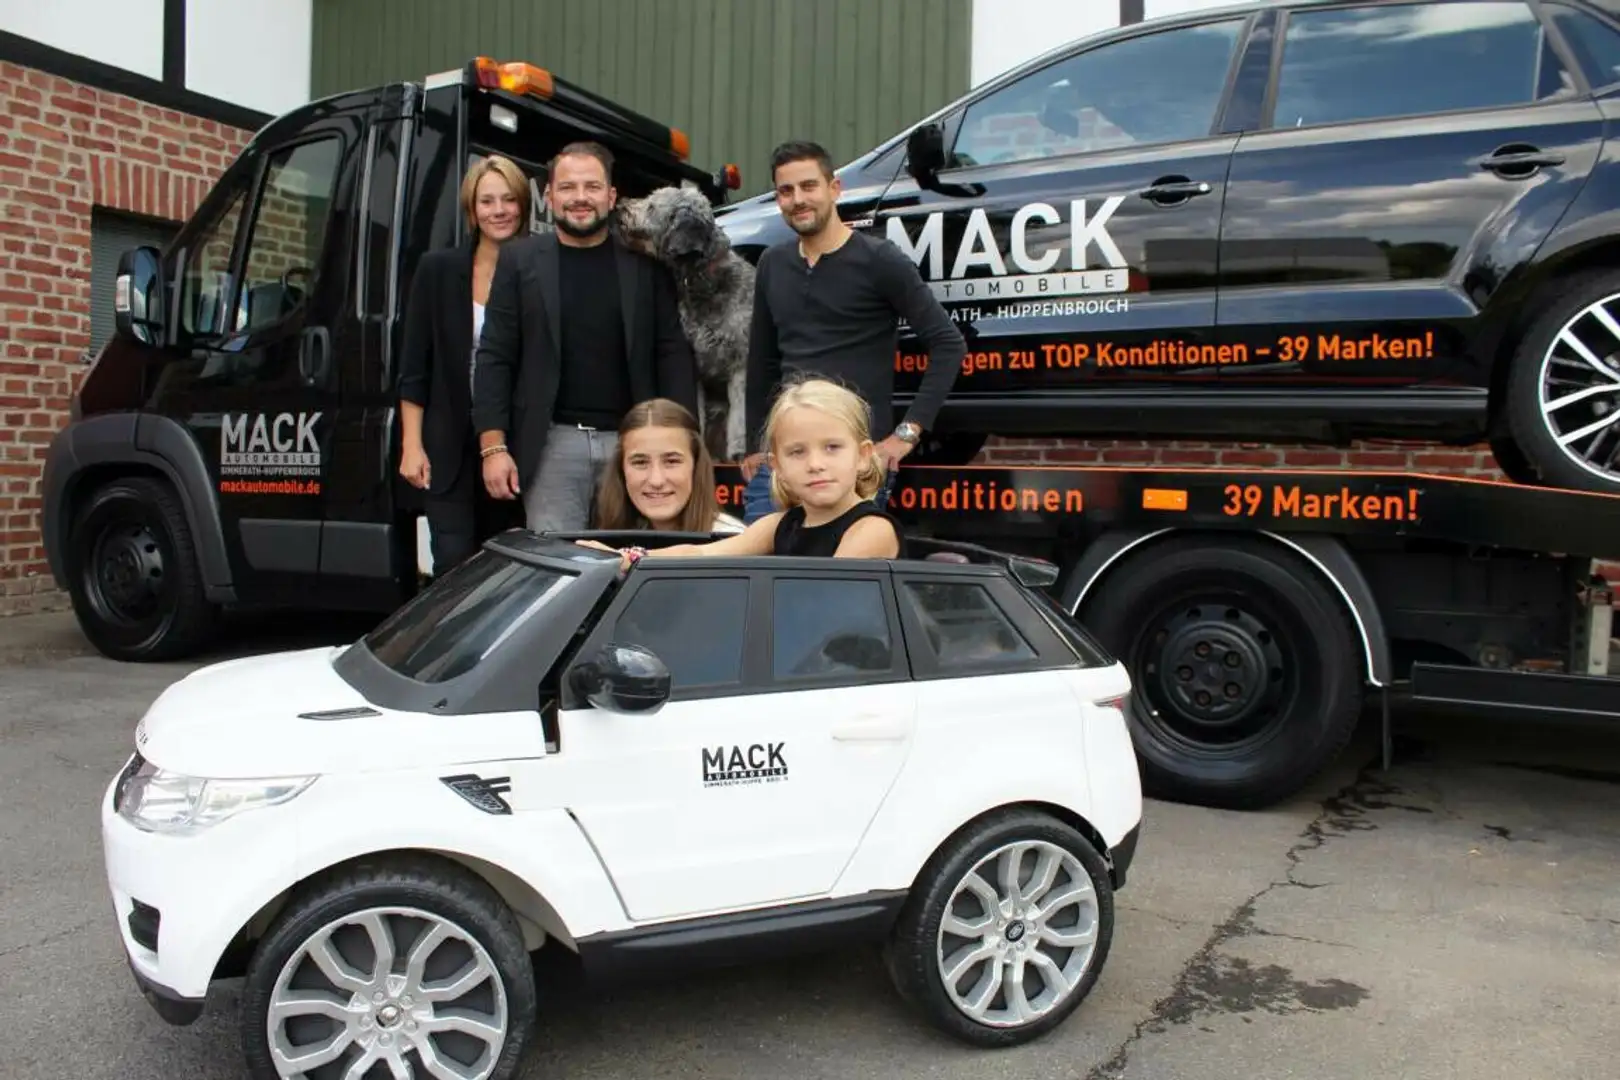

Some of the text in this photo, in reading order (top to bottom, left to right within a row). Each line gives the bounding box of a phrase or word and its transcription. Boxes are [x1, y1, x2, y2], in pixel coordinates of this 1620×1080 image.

[886, 196, 1128, 280] MACK
[943, 274, 1114, 298] TOMOBILE
[997, 299, 1129, 320] HUPPENBROICH
[1008, 350, 1035, 370] zu
[1042, 343, 1089, 368] TOP
[1096, 339, 1248, 366] Konditionen
[1277, 335, 1309, 362] 39
[1317, 331, 1434, 360] Marken!
[221, 411, 322, 453] MACK
[225, 454, 318, 464] AUTOMOBILE
[221, 480, 321, 494] mackautomobile.de
[1223, 484, 1418, 520] 39 Marken!
[702, 742, 787, 774] MACK
